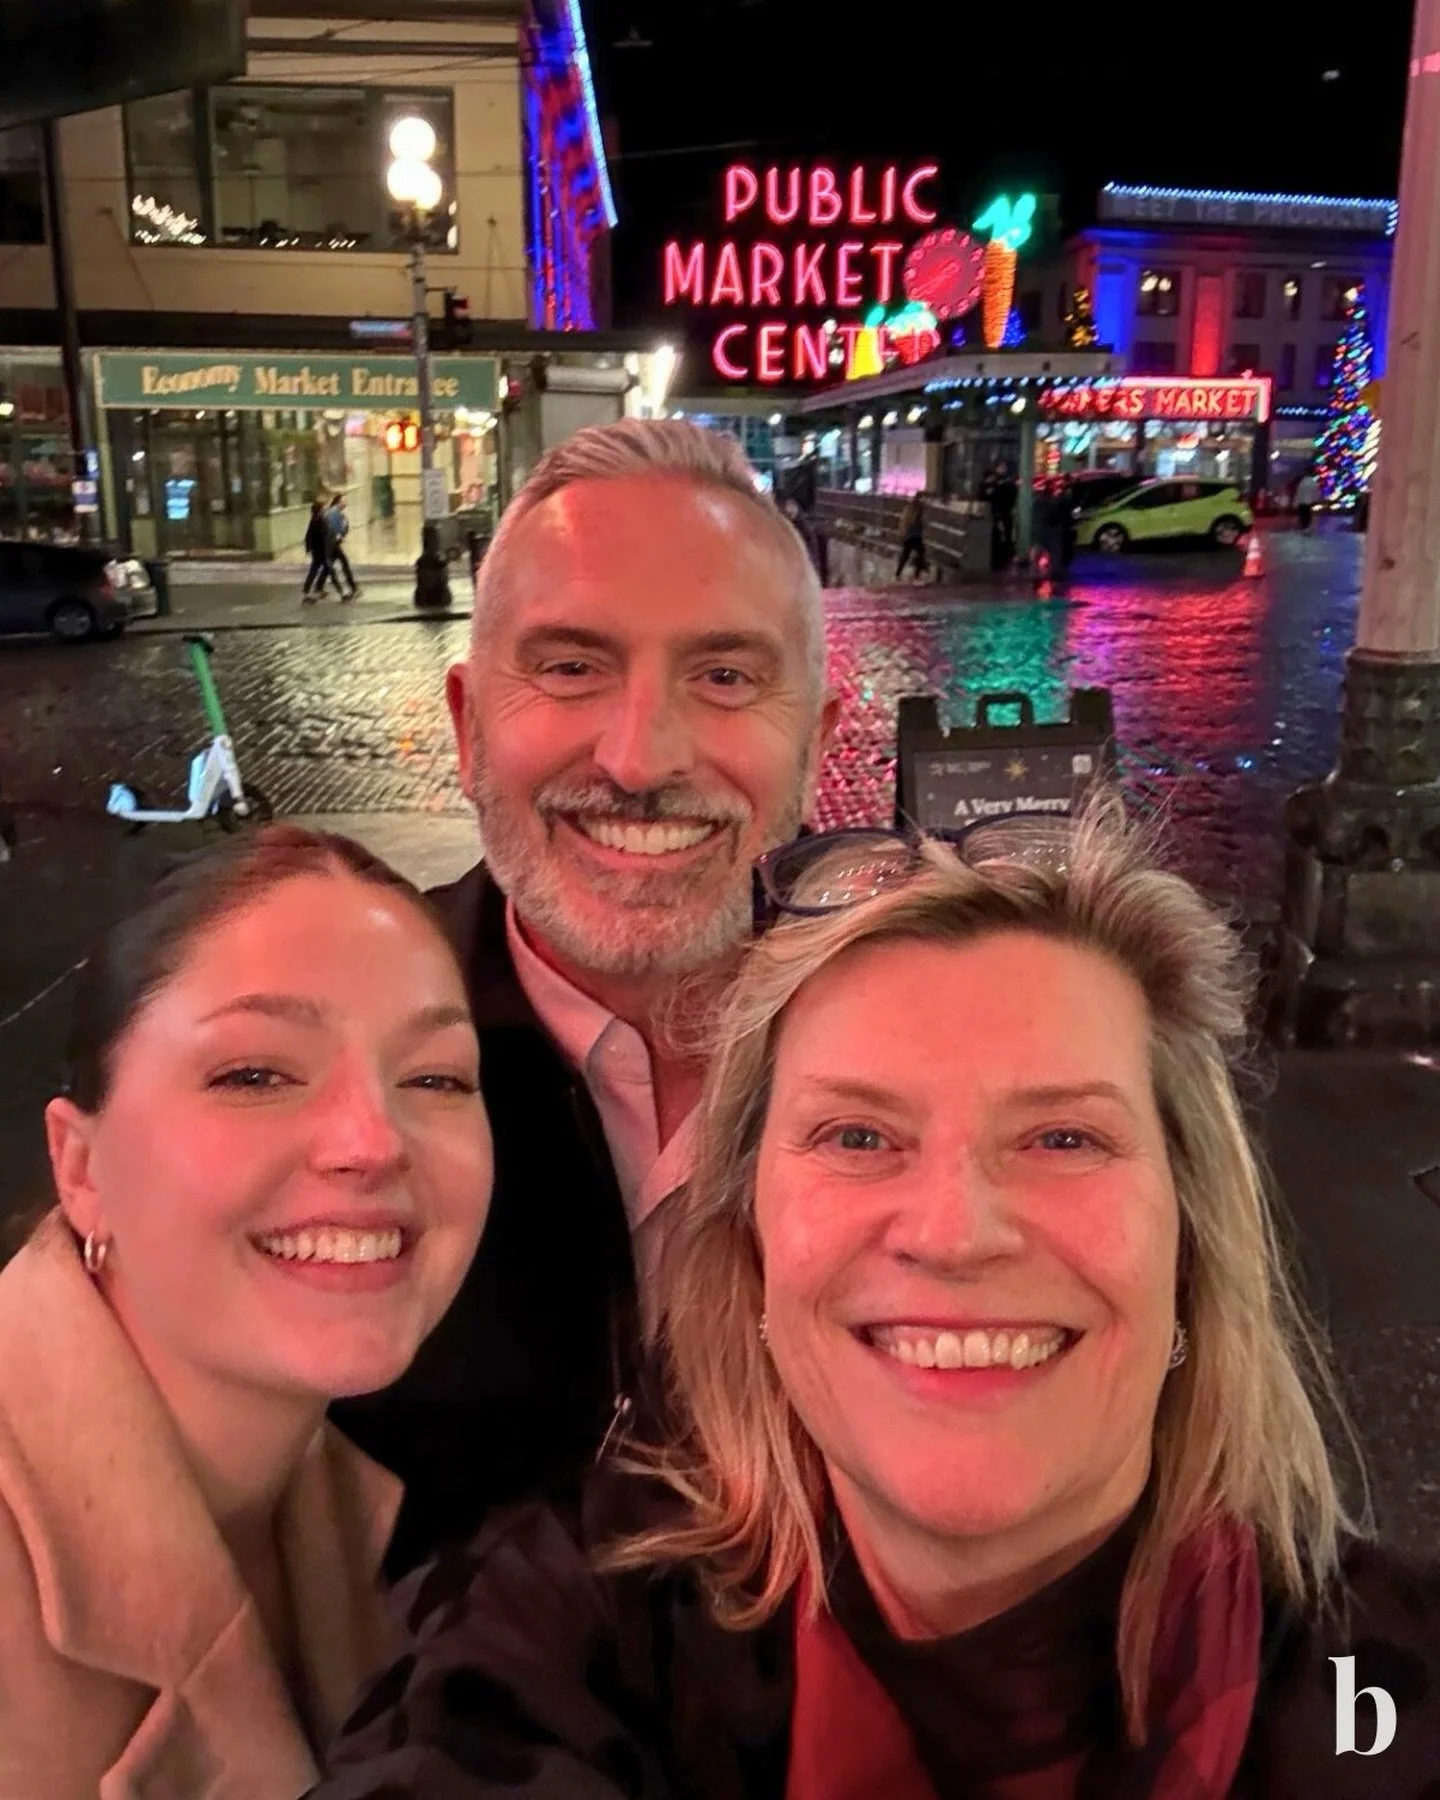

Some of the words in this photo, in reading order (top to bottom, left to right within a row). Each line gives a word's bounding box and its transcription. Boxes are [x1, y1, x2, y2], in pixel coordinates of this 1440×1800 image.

[724, 165, 939, 225] PUBLIC
[663, 242, 904, 306] MARKET
[142, 365, 244, 394] Economy
[254, 366, 341, 397] Market
[352, 366, 460, 397] Entrace
[1154, 386, 1258, 415] MARKET
[953, 799, 971, 816] A
[971, 797, 1014, 816] Very
